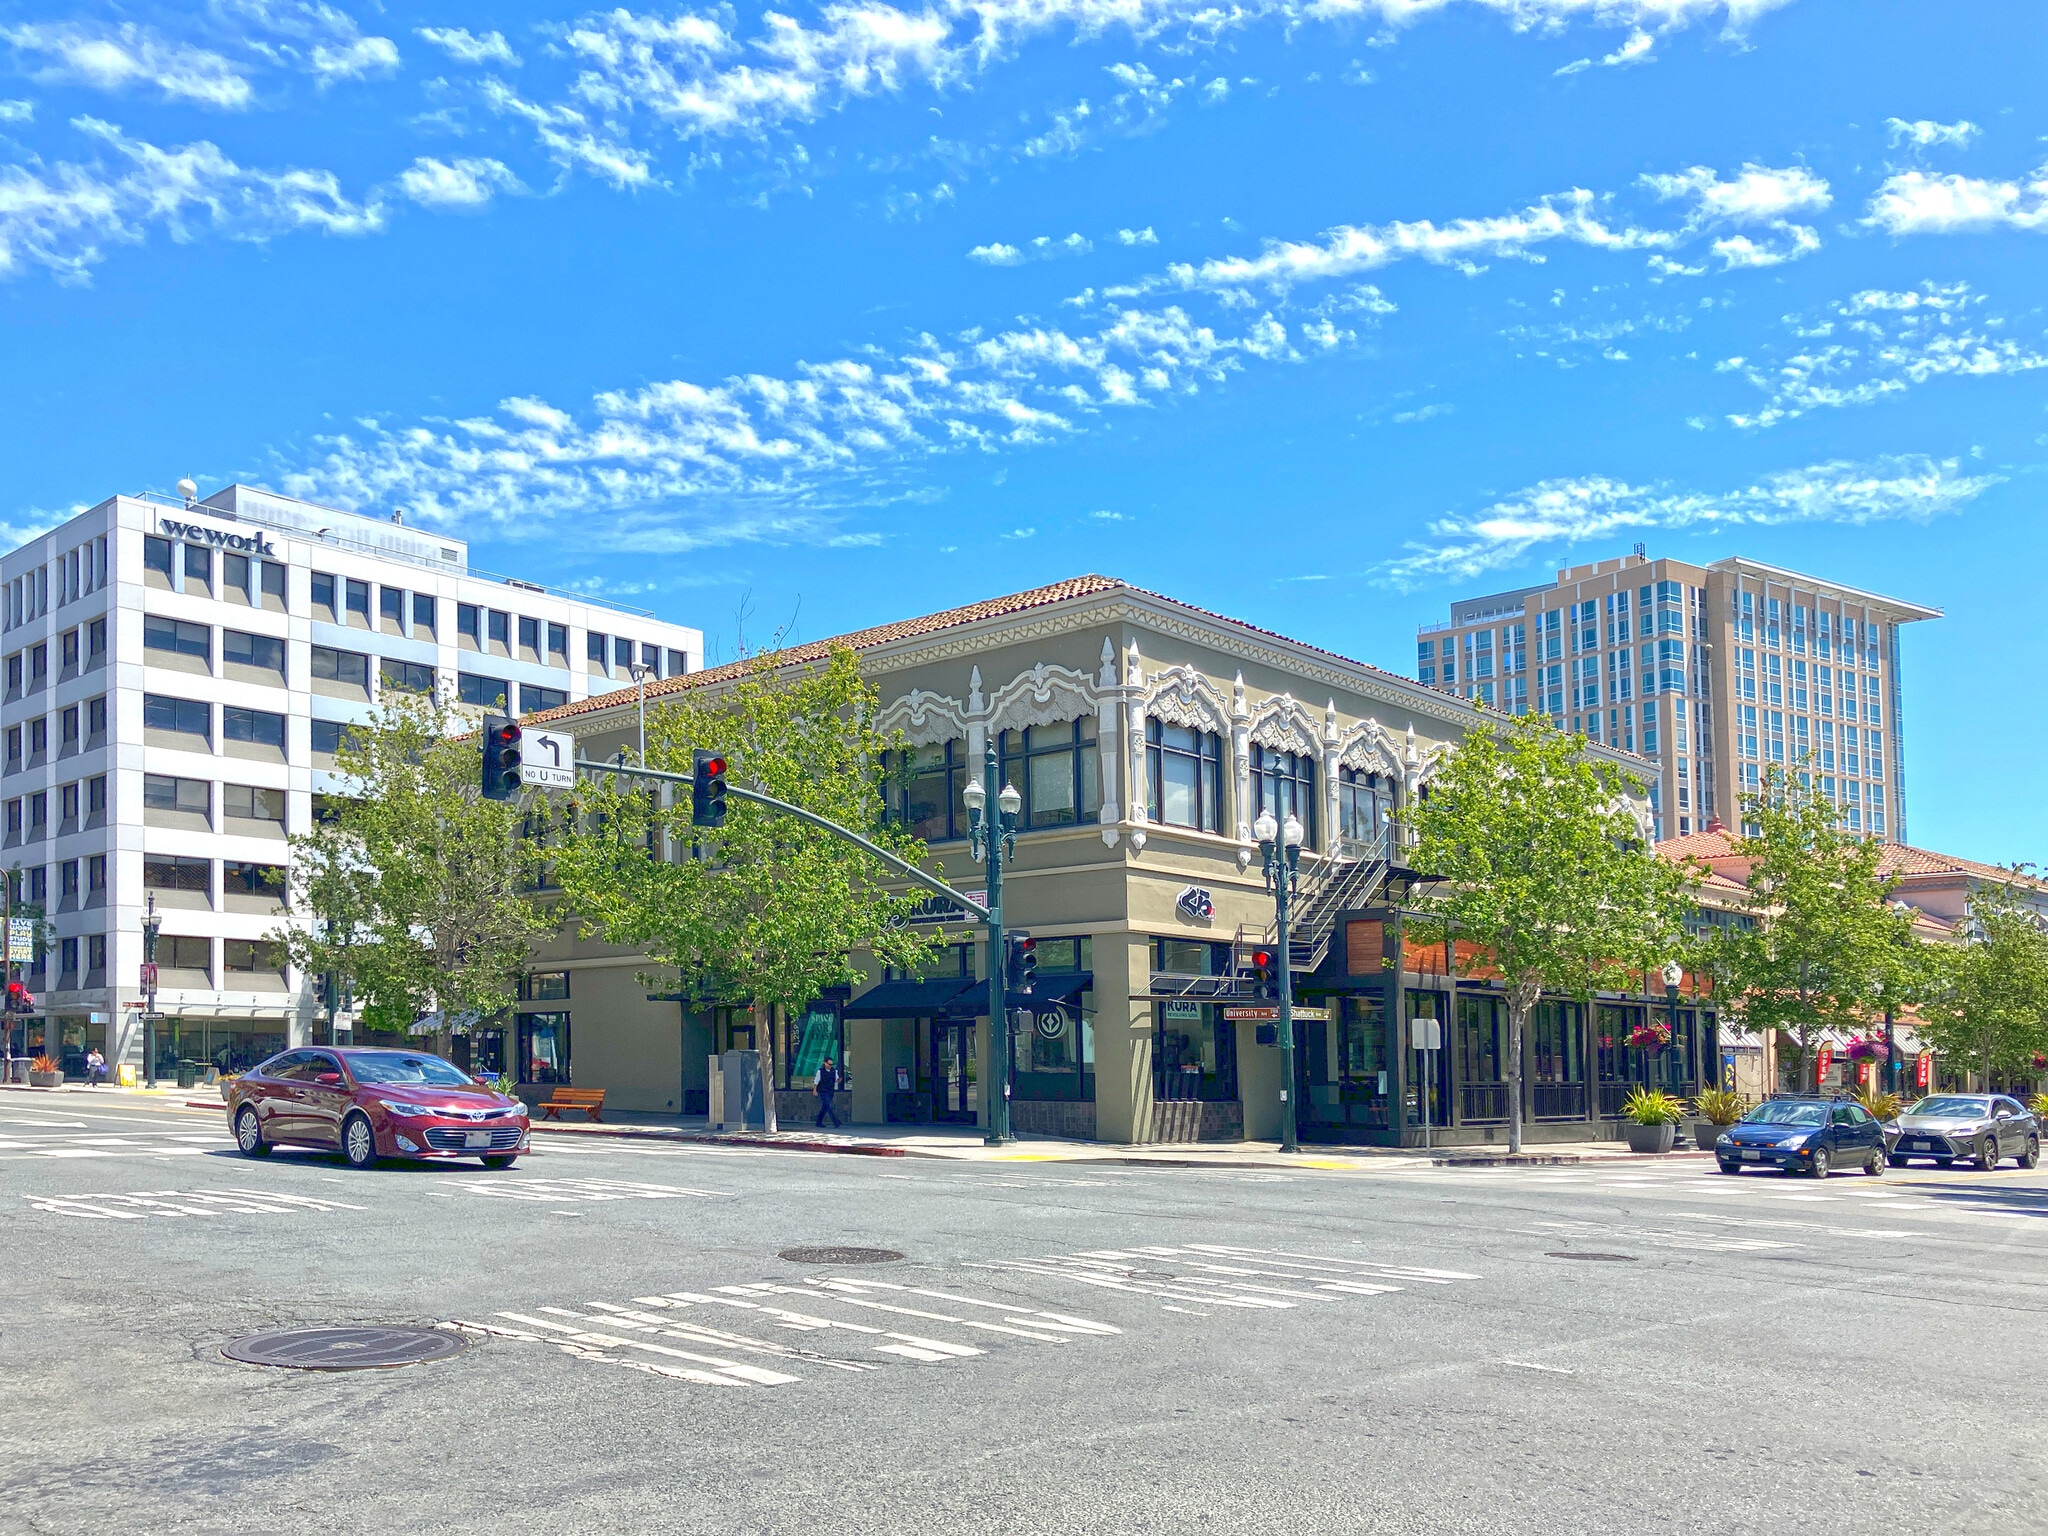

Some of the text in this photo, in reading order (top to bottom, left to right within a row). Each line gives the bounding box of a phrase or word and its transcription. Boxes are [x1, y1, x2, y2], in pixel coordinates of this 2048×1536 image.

[160, 518, 276, 557] wework
[525, 770, 572, 783] NO U TURN
[9, 929, 32, 938] PLAY
[1167, 1001, 1198, 1012] KURA
[1225, 1009, 1258, 1018] University
[1290, 1009, 1315, 1018] Shattuck
[1820, 1052, 1829, 1081] OPEN
